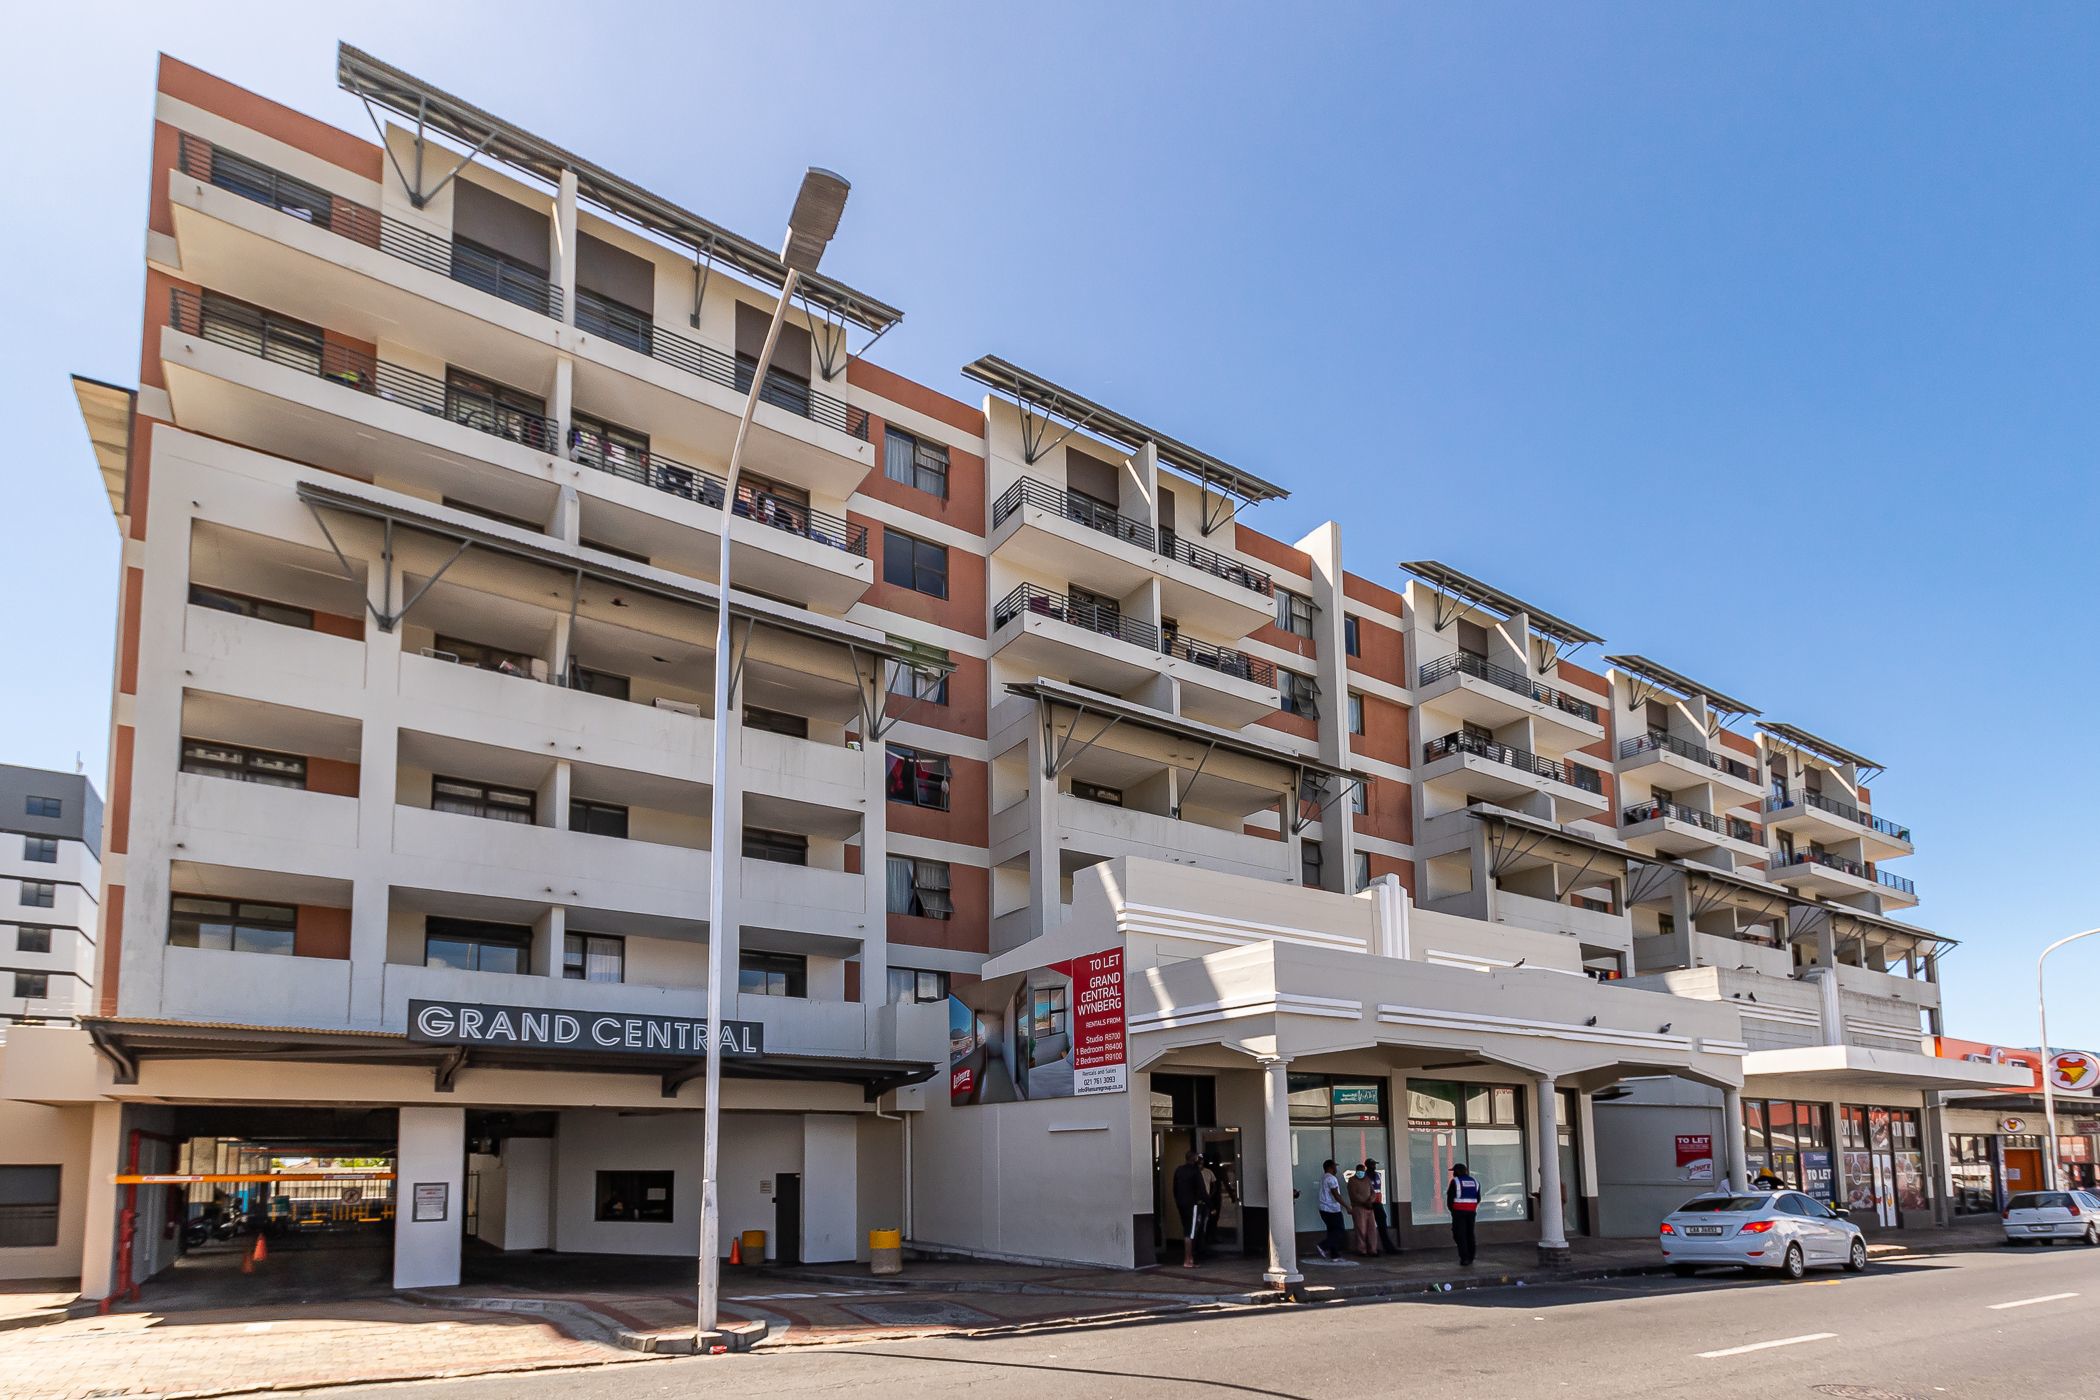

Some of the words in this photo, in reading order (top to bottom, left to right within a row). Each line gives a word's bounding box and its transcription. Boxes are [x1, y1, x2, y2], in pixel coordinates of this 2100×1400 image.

[1090, 959, 1101, 971] TO
[1103, 954, 1120, 968] LET
[1090, 972, 1120, 988] GRAND
[1081, 985, 1121, 1003] CENTRAL
[1077, 997, 1122, 1016] WYNBERG
[417, 1006, 580, 1043] GRAND
[592, 1018, 757, 1053] CENTRAL
[1086, 1019, 1106, 1028] RENTALS
[1085, 1034, 1104, 1044] Studio
[1080, 1046, 1104, 1055] Bedroom
[1075, 1058, 1080, 1066] 2
[1080, 1055, 1104, 1065] Bedroom
[1806, 1169, 1817, 1180] TO
[1818, 1168, 1832, 1180] LET
